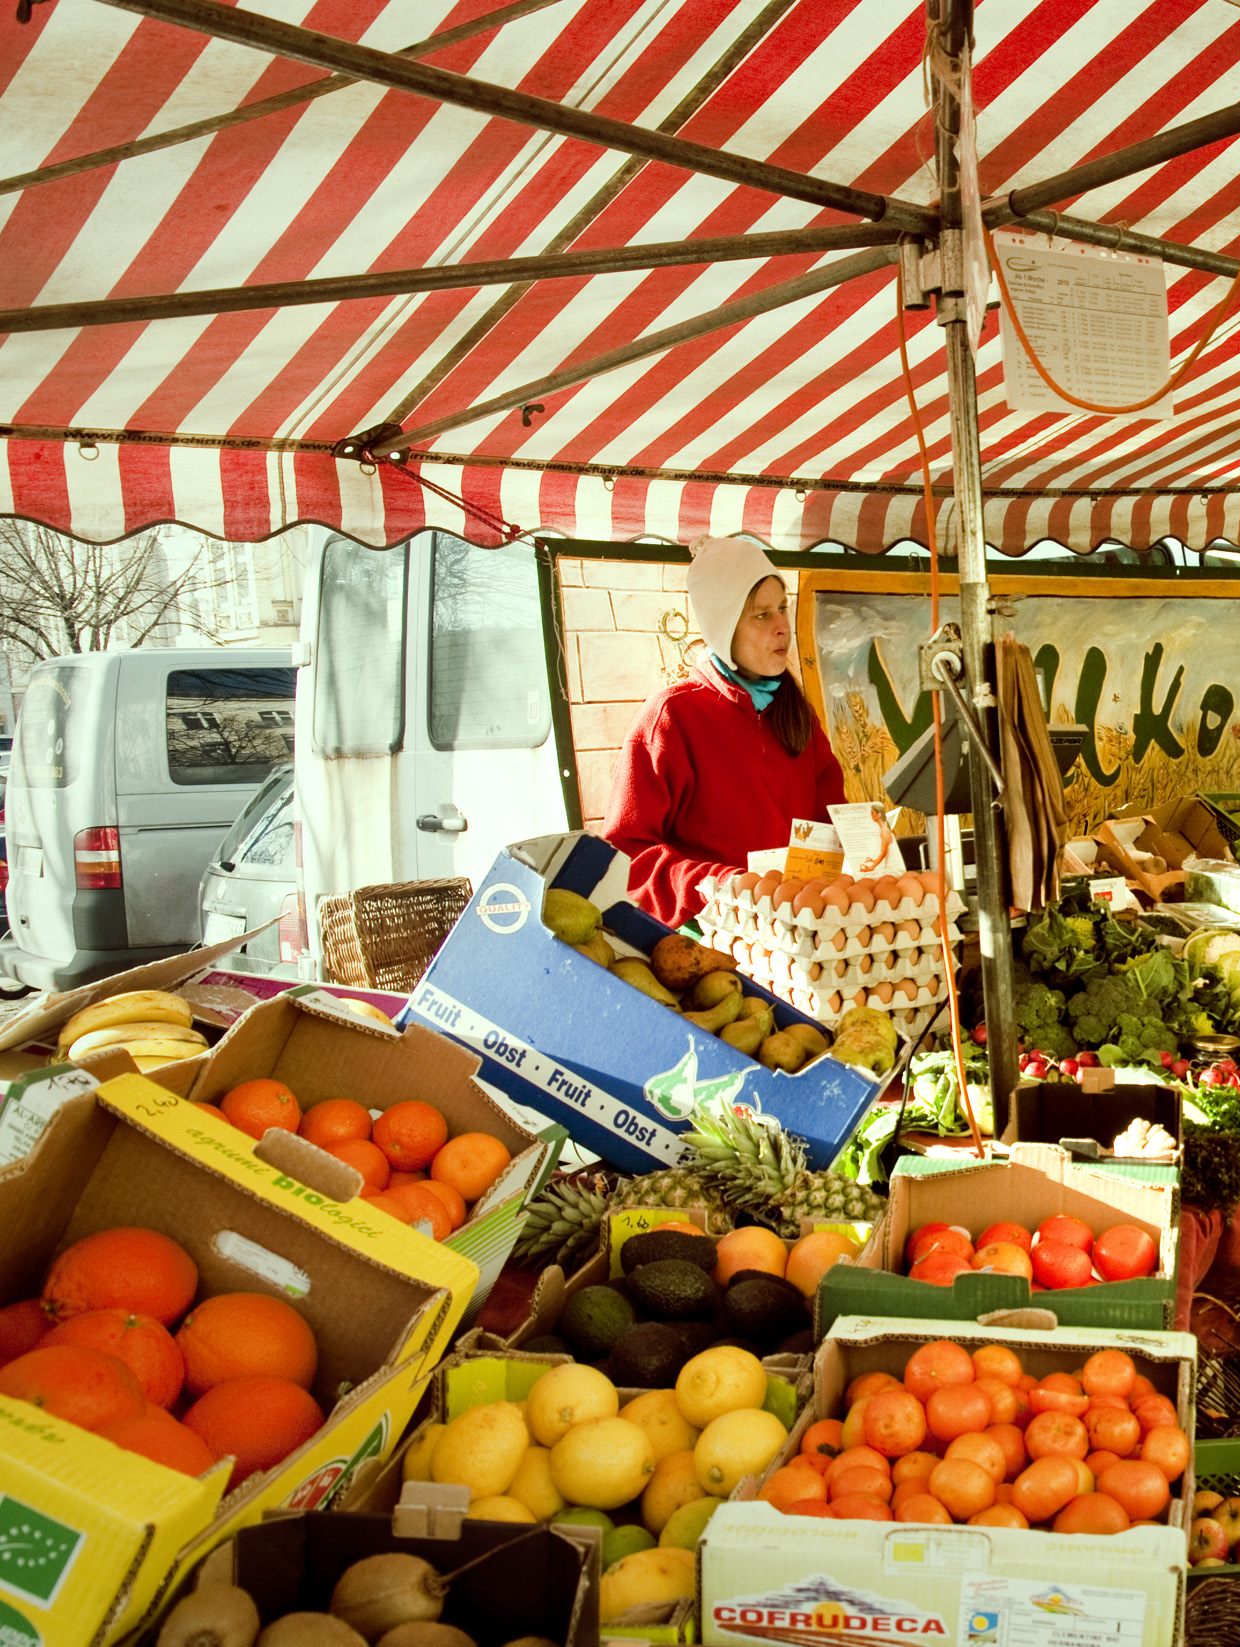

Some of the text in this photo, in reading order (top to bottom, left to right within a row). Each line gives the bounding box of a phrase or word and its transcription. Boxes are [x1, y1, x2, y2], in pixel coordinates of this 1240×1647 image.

[63, 430, 260, 447] www.plana-schirme.de
[498, 459, 646, 478] www.plana-schirme.de
[674, 470, 799, 488] www.plana-schirme.de
[479, 902, 530, 914] QUALITY
[416, 987, 658, 1147] Fruit Obst Fruit Obst
[186, 1128, 271, 1176] agrumi
[713, 1600, 947, 1636] COFRUDECA
